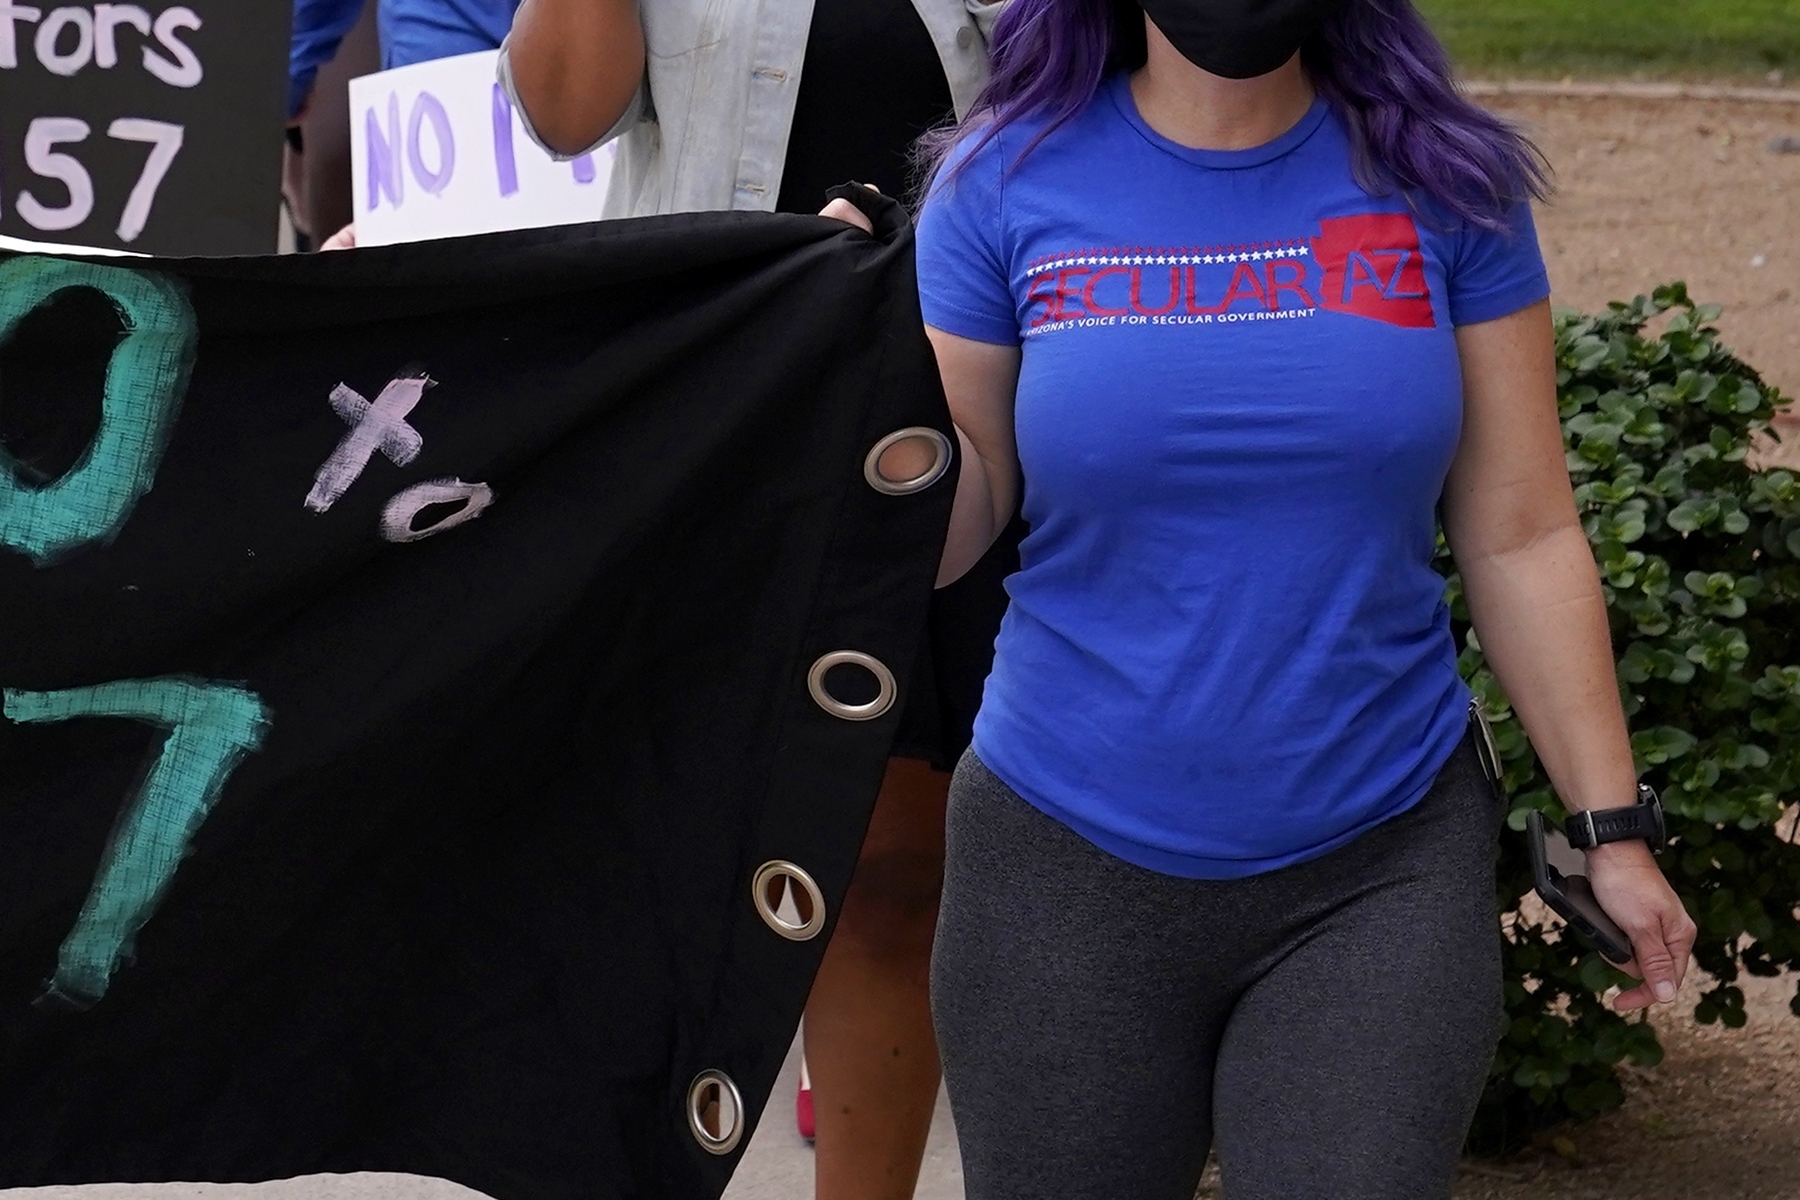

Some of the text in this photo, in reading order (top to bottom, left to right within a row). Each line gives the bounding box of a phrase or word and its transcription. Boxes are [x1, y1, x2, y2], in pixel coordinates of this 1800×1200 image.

[365, 89, 455, 212] NO
[1027, 249, 1424, 327] SECULAR AZ
[1078, 315, 1116, 328] VOICE
[1121, 315, 1147, 325] FOR
[1152, 314, 1213, 325] SECULAR
[1217, 308, 1316, 323] GOVERNMENT
